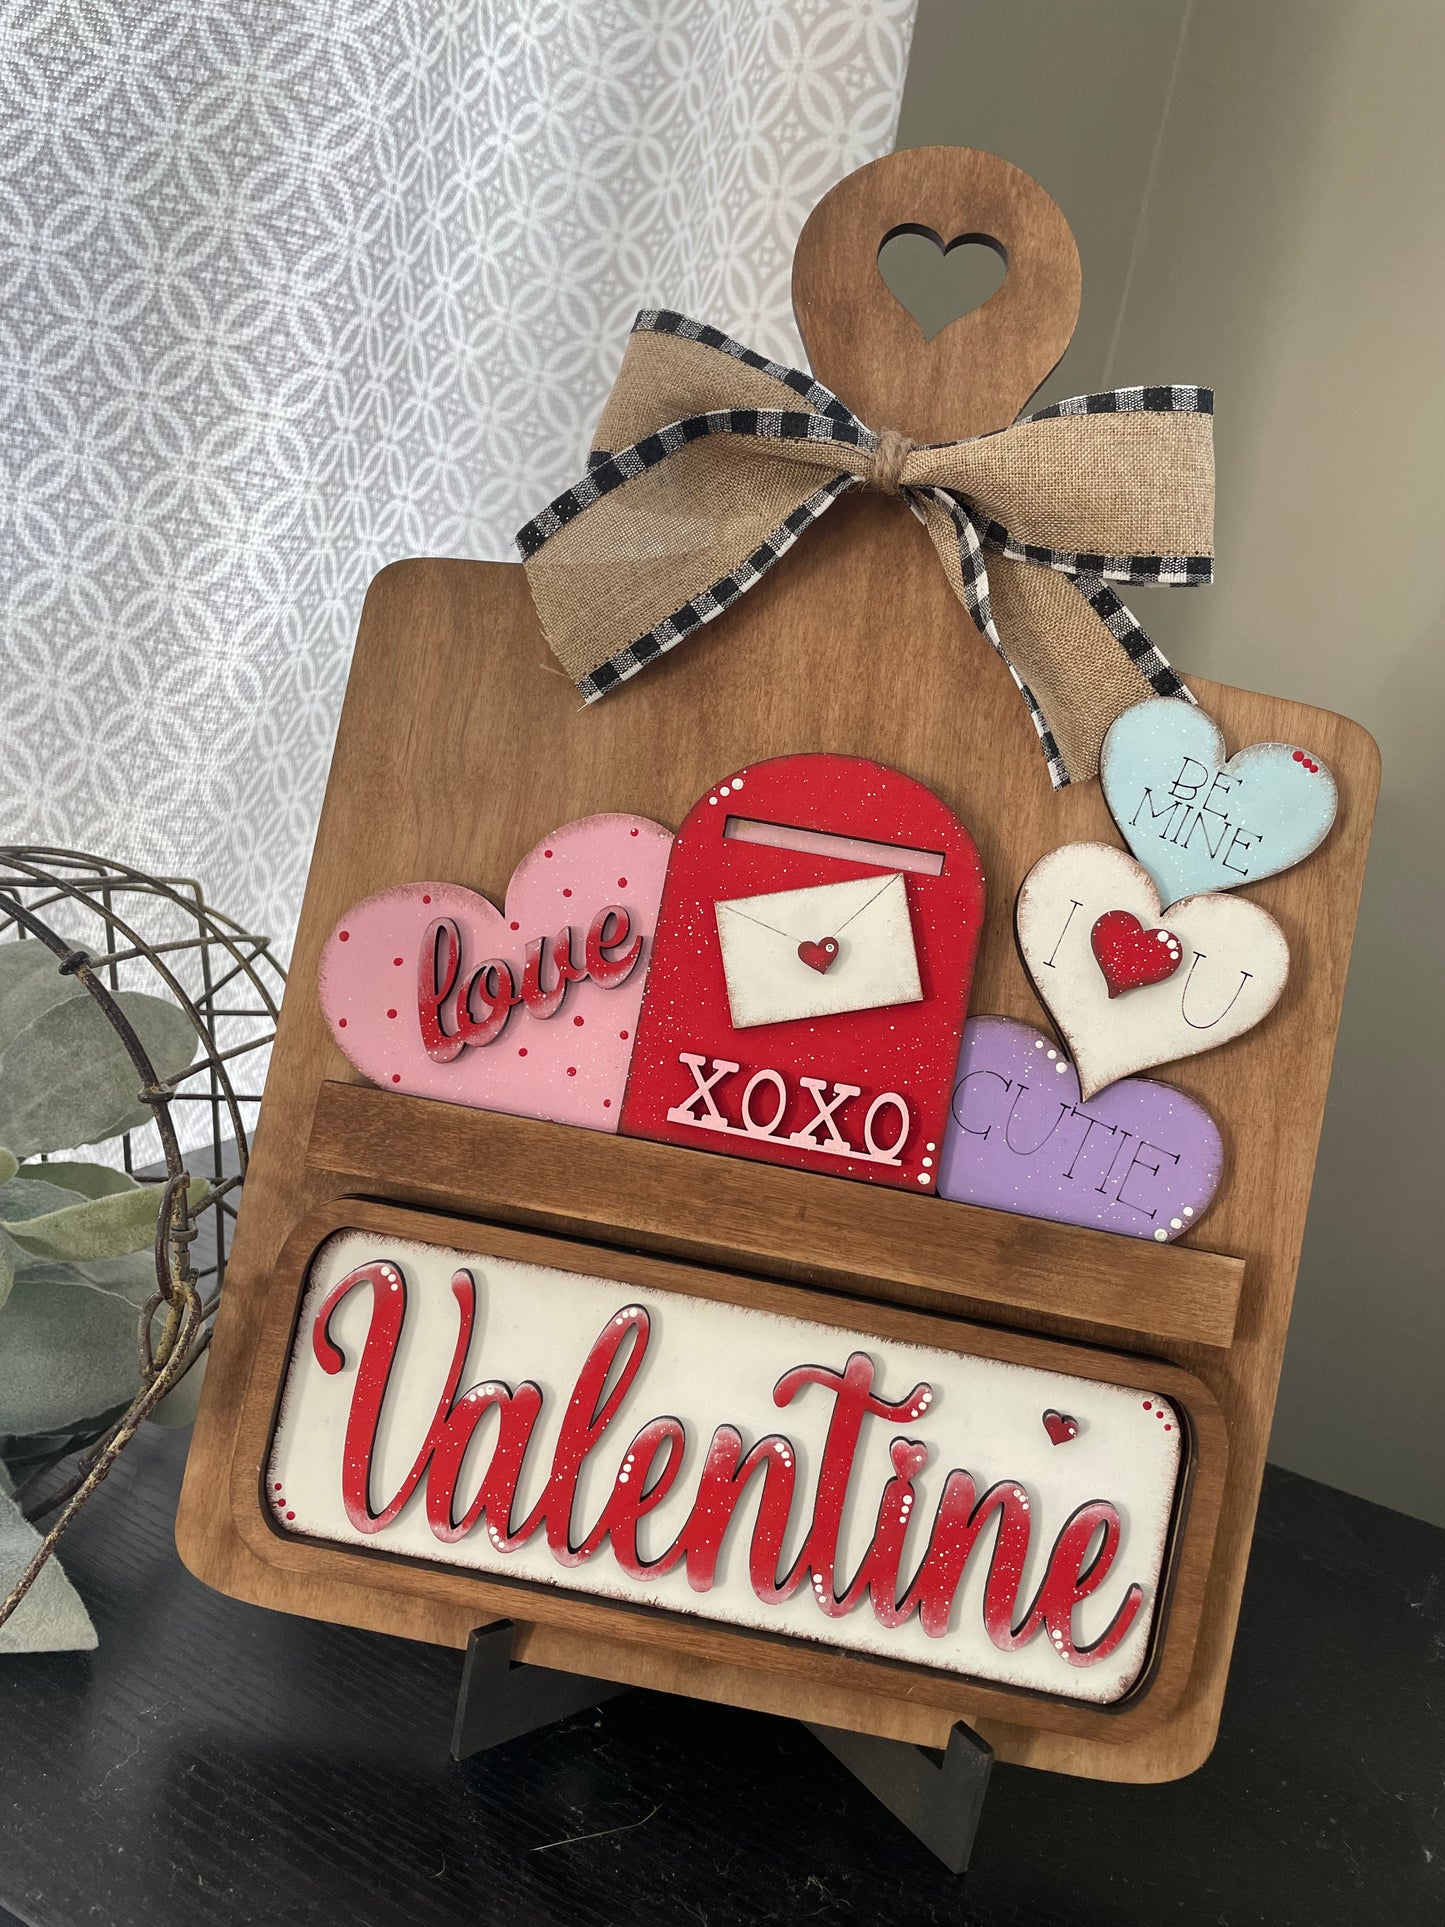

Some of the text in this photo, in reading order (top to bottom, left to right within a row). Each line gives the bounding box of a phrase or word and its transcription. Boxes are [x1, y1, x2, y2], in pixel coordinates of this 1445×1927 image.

[1127, 788, 1263, 876] MINE
[1168, 756, 1243, 820] BE
[417, 905, 645, 1064] love
[1043, 900, 1253, 1030] I U
[667, 1052, 910, 1166] XOXO
[951, 1070, 1181, 1220] CUTIE
[312, 1258, 1143, 1668] Valentine
